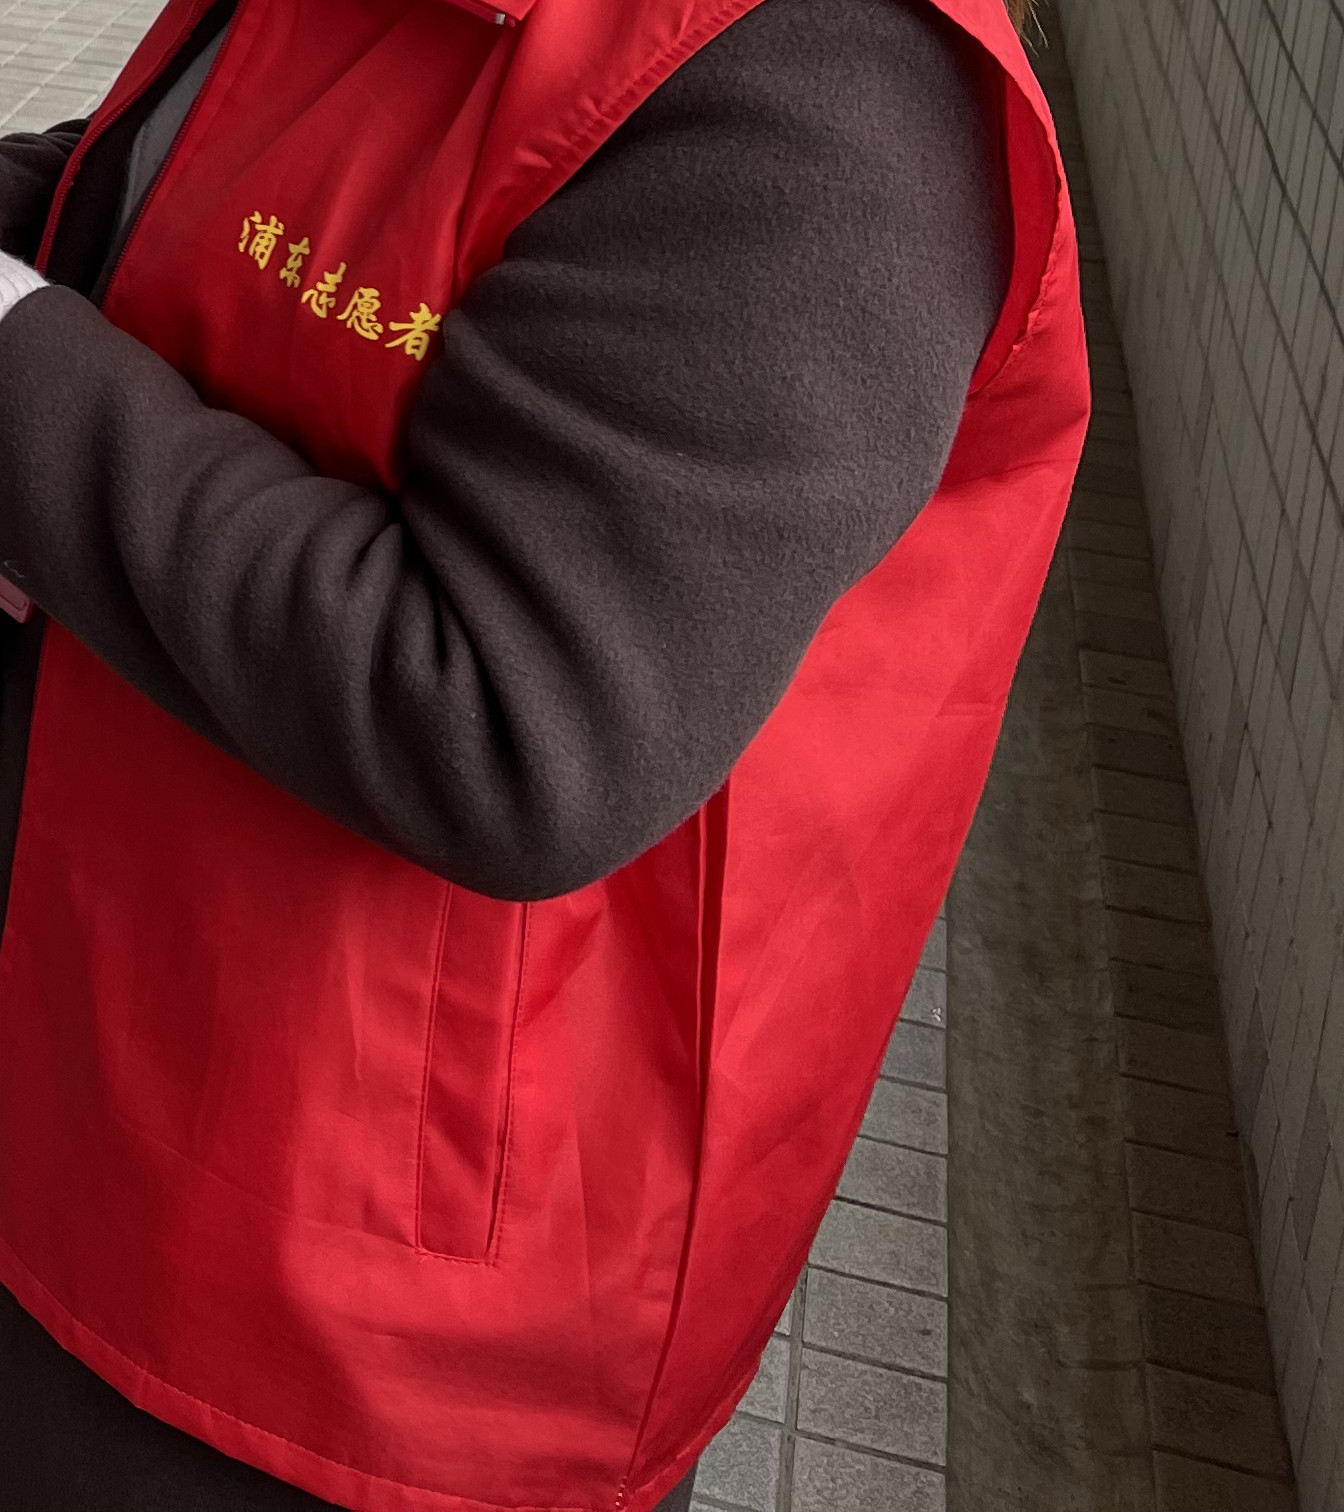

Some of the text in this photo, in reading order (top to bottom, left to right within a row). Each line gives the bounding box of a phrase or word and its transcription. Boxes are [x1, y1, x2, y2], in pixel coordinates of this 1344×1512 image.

[238, 210, 442, 361] 浦东志愿者
